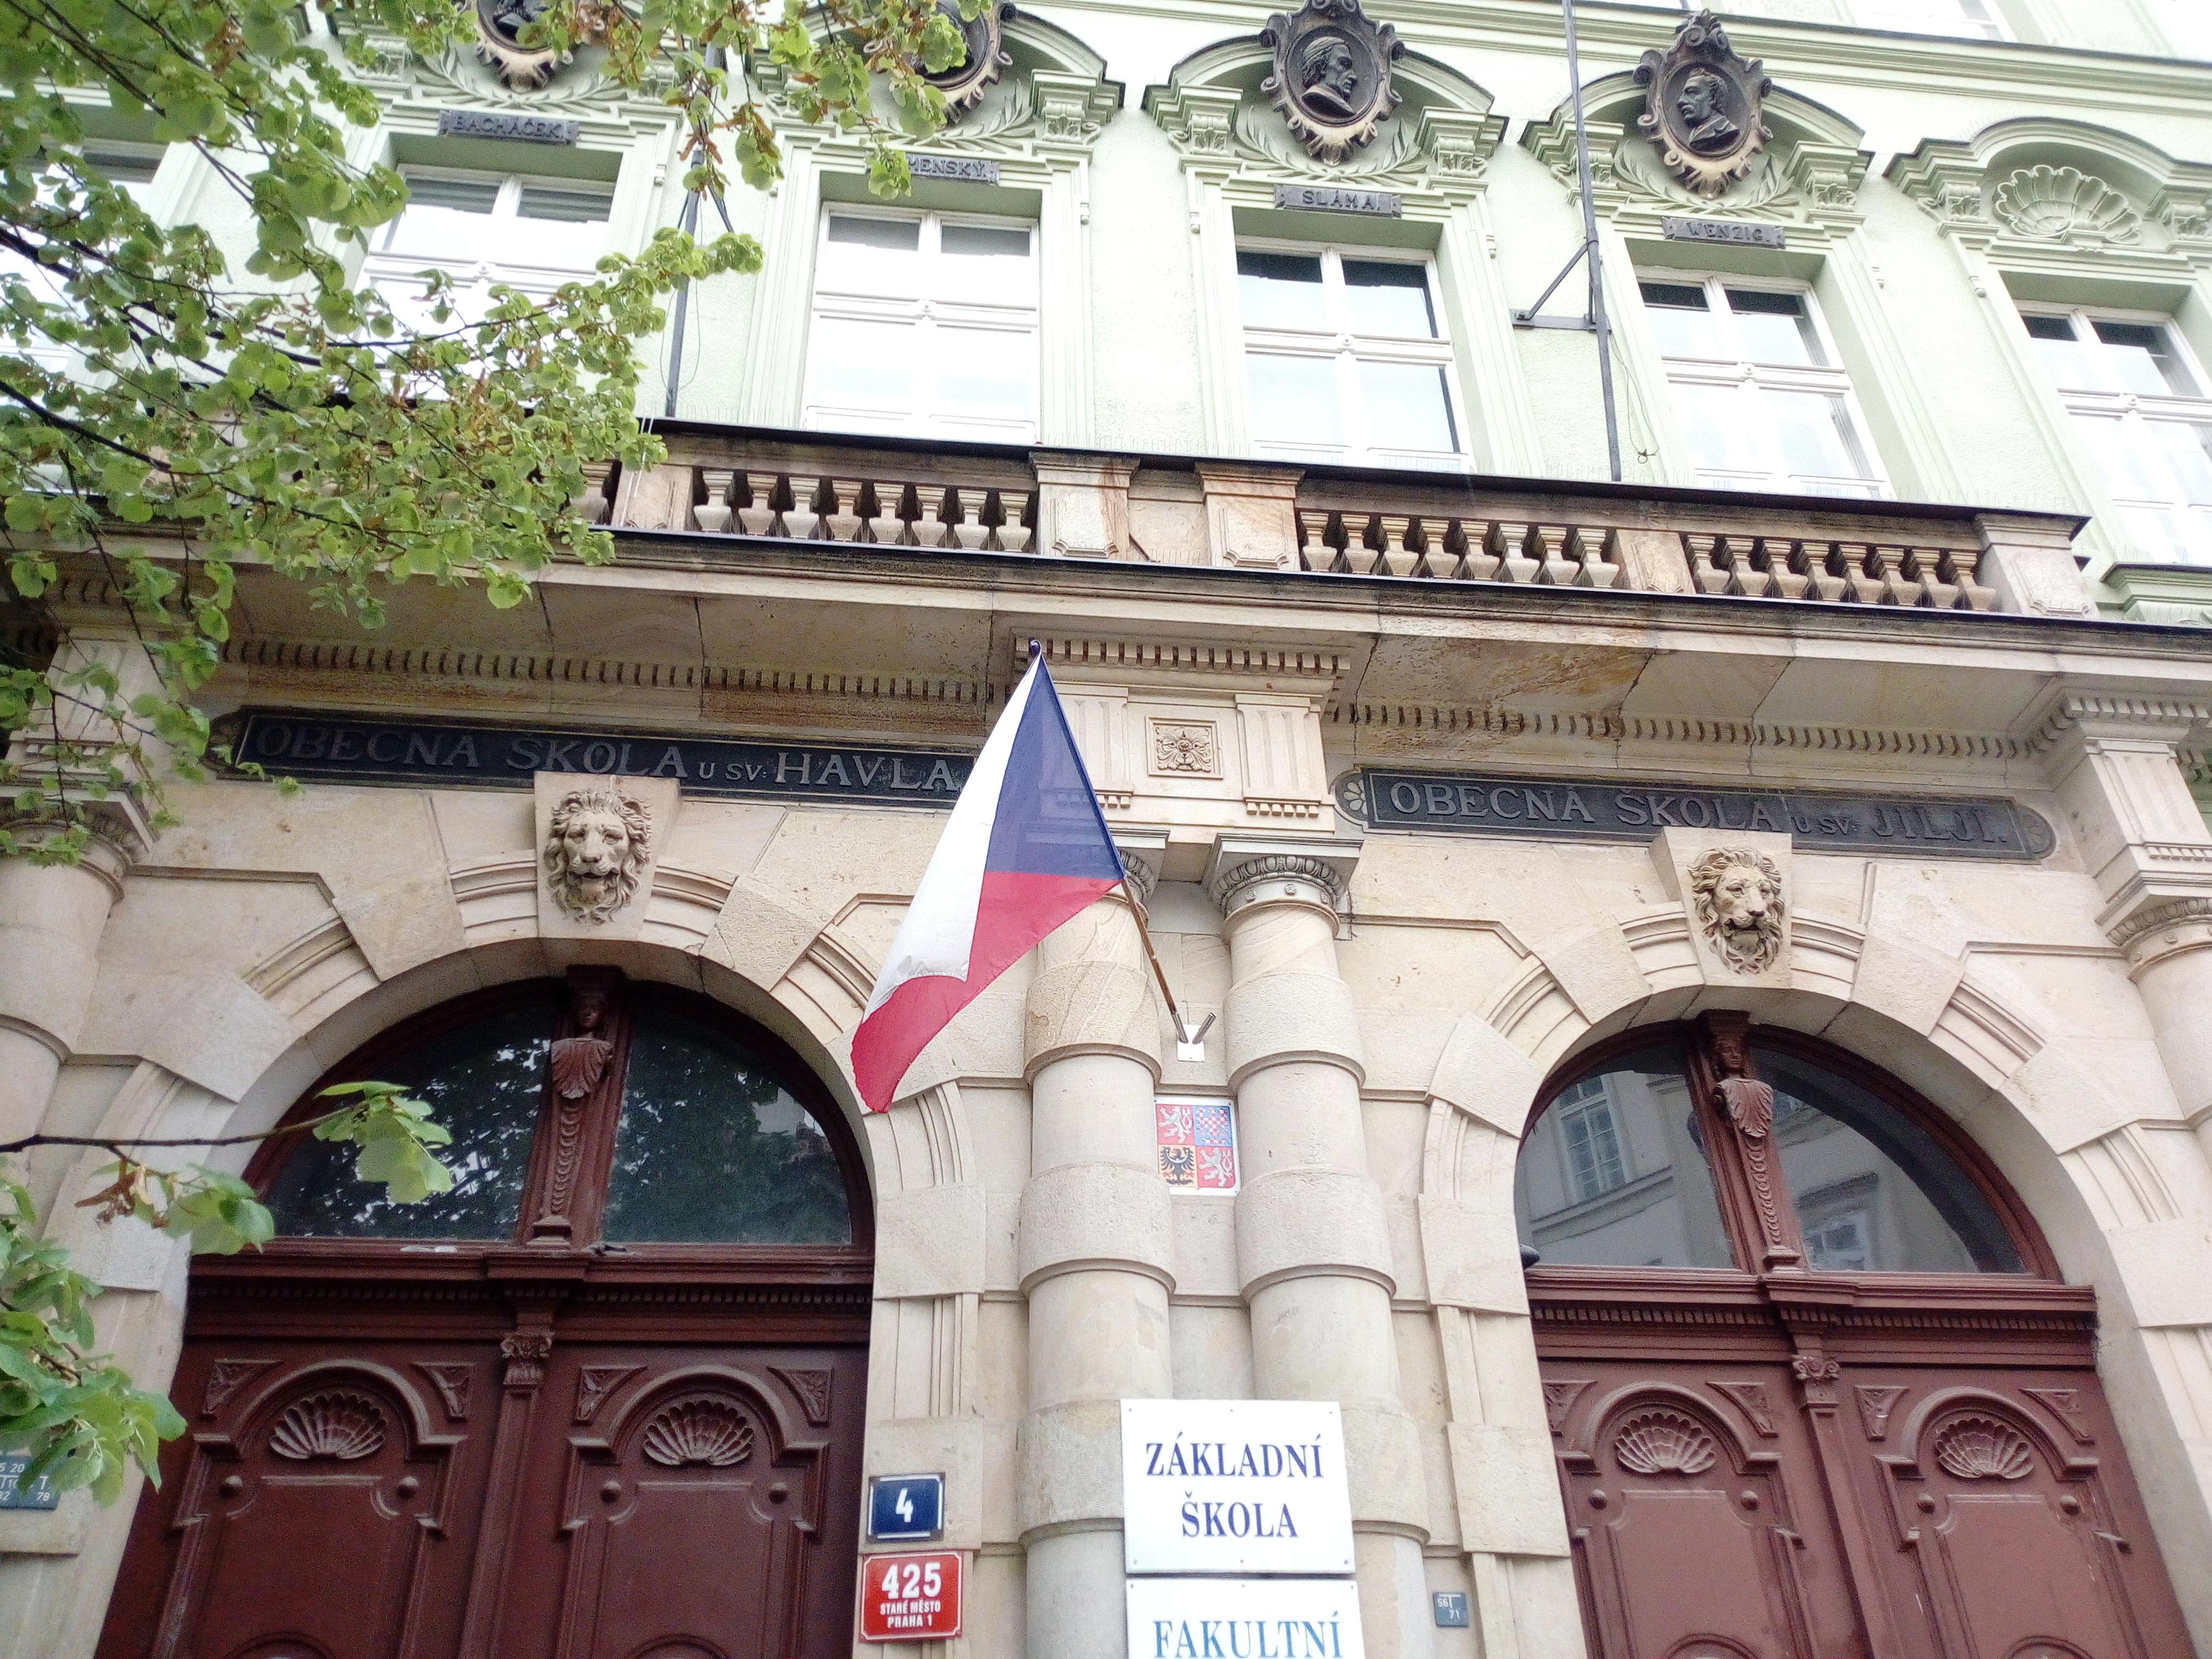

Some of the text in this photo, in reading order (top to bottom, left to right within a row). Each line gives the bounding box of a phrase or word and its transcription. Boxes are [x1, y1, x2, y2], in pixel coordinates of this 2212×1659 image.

[1146, 1431, 1324, 1478] ZÁKLADNÍ
[895, 1488, 914, 1523] 4
[1181, 1491, 1298, 1537] ŠKOLA
[881, 1562, 942, 1599] 425
[880, 1598, 941, 1615] STARÉ MĚSTO
[888, 1614, 933, 1628] PRAHA 1
[1152, 1610, 1344, 1658] FAKULTNÍ
